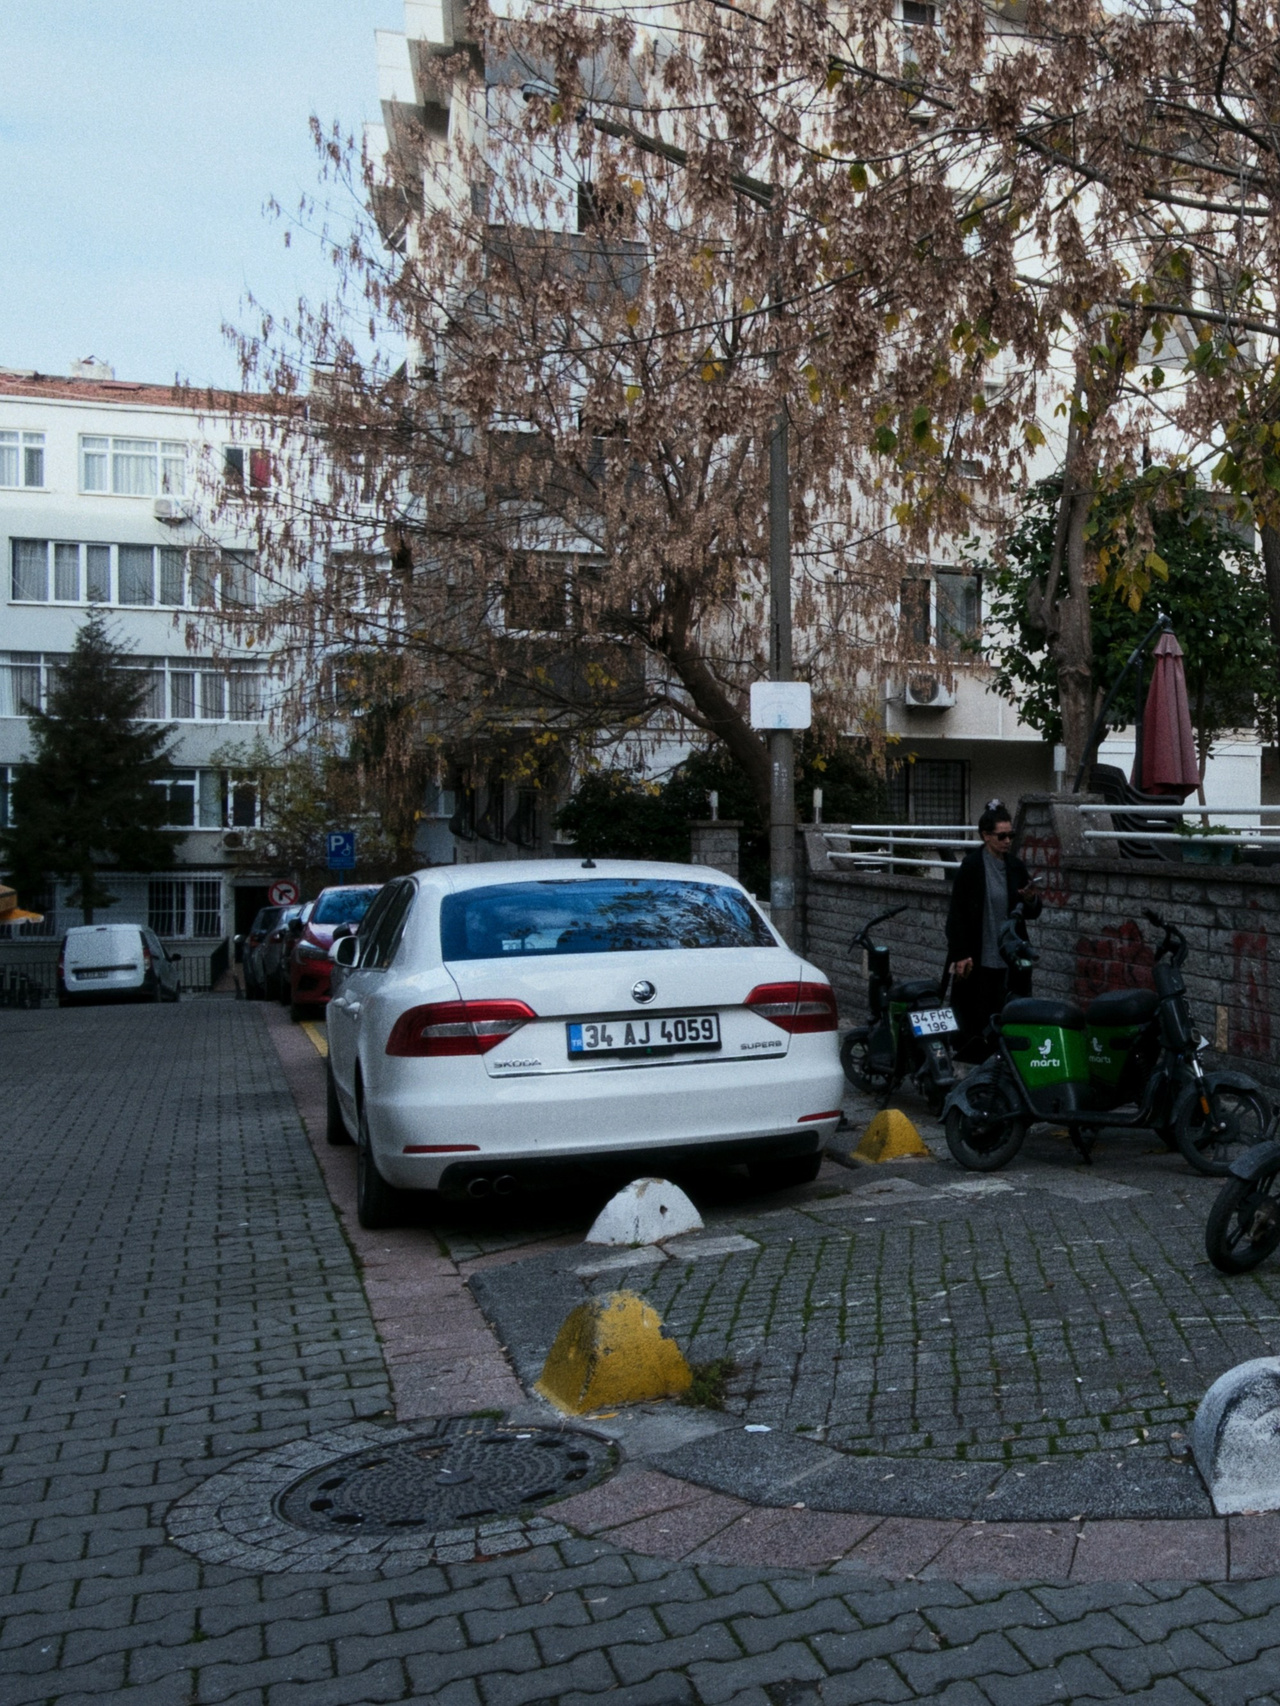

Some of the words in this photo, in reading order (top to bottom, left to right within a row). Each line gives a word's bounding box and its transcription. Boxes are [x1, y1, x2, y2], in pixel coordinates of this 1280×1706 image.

[330, 835, 345, 851] P
[912, 1012, 928, 1024] 34
[927, 1021, 948, 1032] 196
[585, 1024, 613, 1048] 34
[624, 1021, 650, 1046] AJ
[661, 1018, 714, 1043] 4059
[740, 1040, 783, 1050] SUPERB
